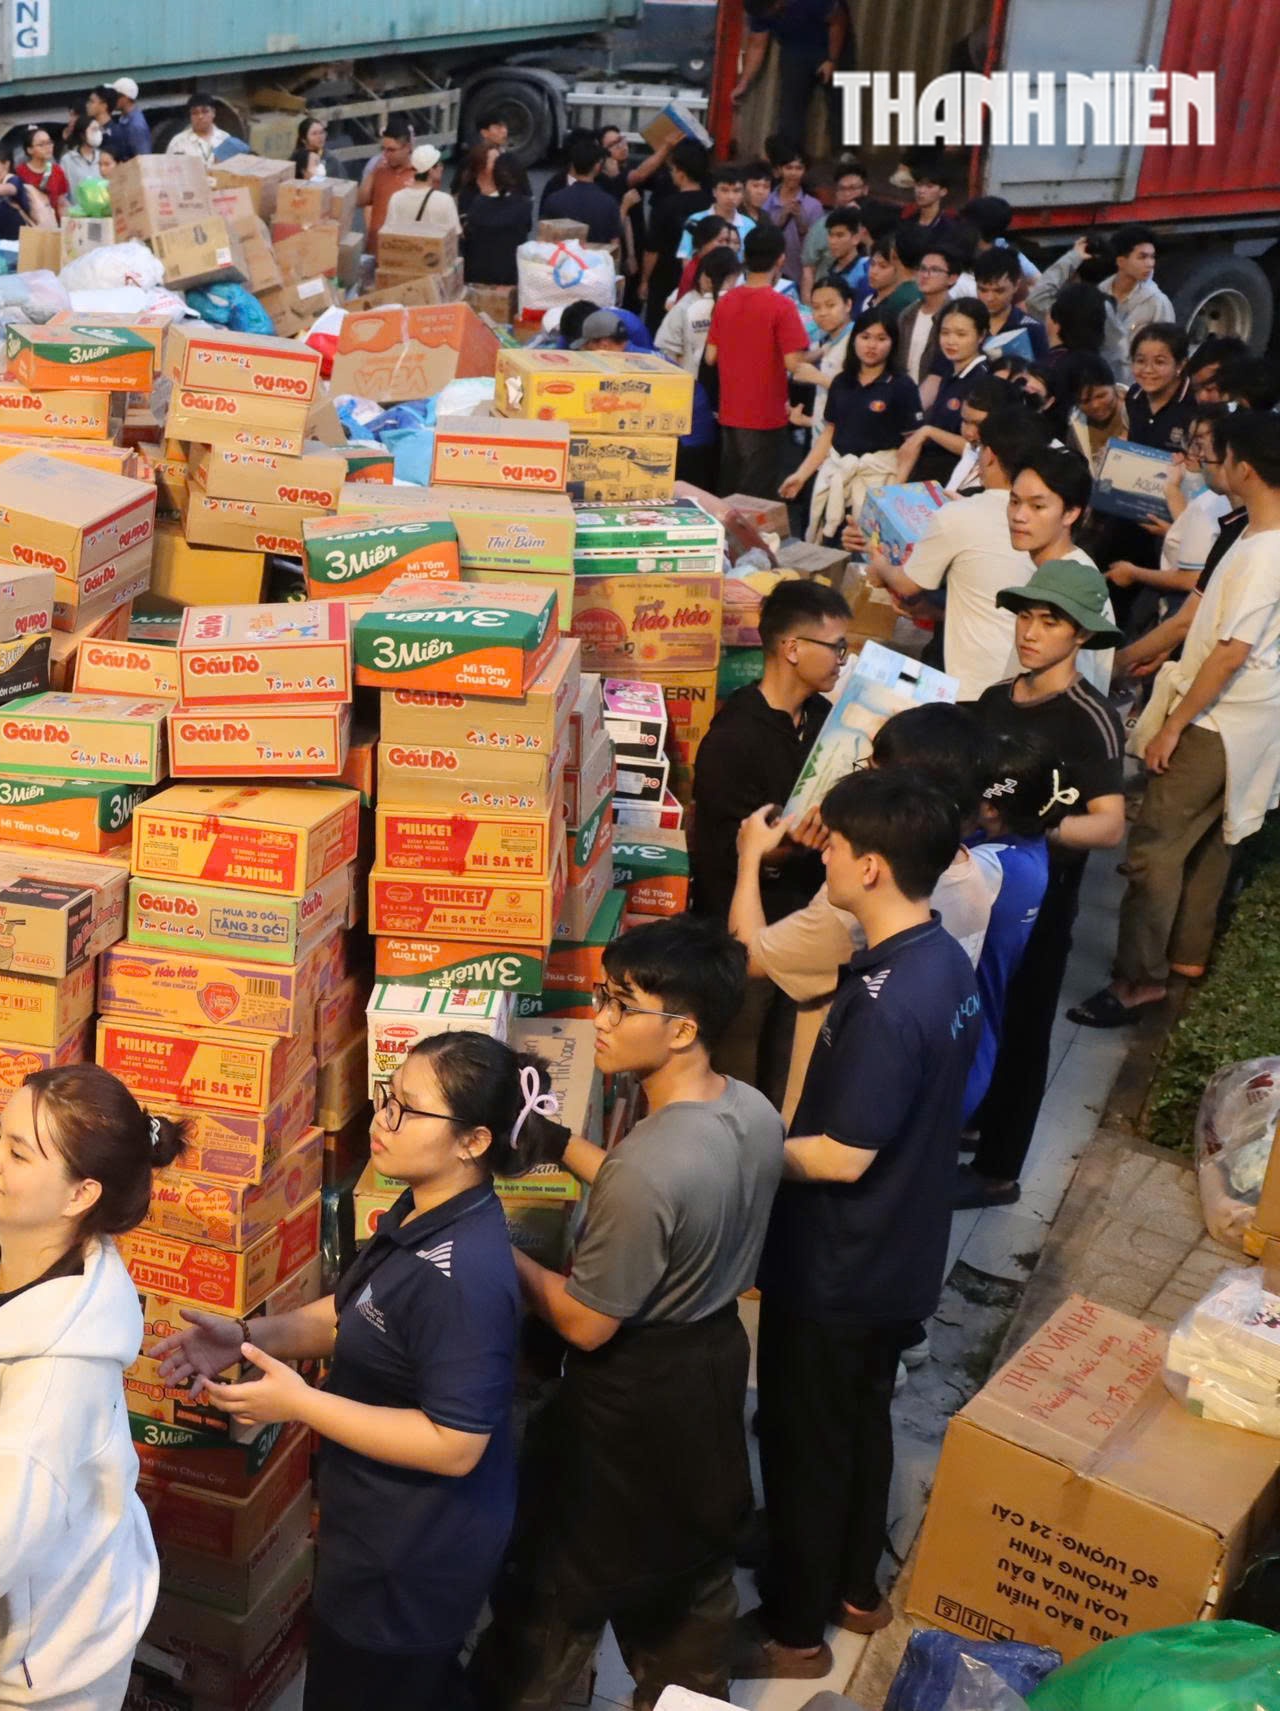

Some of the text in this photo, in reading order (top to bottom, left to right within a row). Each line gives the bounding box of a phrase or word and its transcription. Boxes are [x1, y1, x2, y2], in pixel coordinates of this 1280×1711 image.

[22, 396, 42, 410] Đỏ
[181, 392, 237, 414] Gấu Đỏ
[502, 464, 558, 483] Gấu Đỏ
[407, 560, 444, 570] Mì Tôm
[430, 569, 450, 578] Cay
[189, 654, 260, 675] Gấu Đỏ
[463, 664, 505, 676] Mì Tôm
[265, 676, 336, 690] Tôm và Gà
[456, 674, 511, 689] Chua Cay
[180, 722, 250, 742] Gấu Đỏ
[466, 731, 542, 748] Gà Sợi Phở
[70, 750, 97, 766] Chay
[100, 752, 122, 764] Rau
[256, 747, 326, 759] Tôm và Gà
[388, 748, 458, 770] Gấu Đỏ
[0, 818, 80, 840] Mì Tôm Chua Cay
[472, 853, 534, 868] MÌ SA TẾ
[224, 864, 283, 883] MILIKET
[137, 893, 198, 916] Gấu Đỏ
[423, 887, 486, 907] MILIKET
[223, 908, 277, 921] MUA 30 GÓI
[432, 913, 448, 924] MÌ
[450, 915, 467, 925] SA
[494, 916, 533, 925] PLASMA
[137, 918, 205, 939] Tôm Chua Cay
[214, 918, 250, 933] TẶNG
[252, 921, 260, 932] 3
[386, 940, 441, 954] Chua Cay
[116, 1036, 174, 1056] MILIKET
[190, 1078, 252, 1098] MÌ SA TẾ
[992, 1503, 1160, 1589] SỐ LƯỢNG: 24 CÁI
[1009, 1537, 1128, 1601] KHÔNG KÍNH
[996, 1582, 1040, 1611] HIỂM
[997, 1557, 1130, 1627] LOẠI NỬA ĐẦU
[1044, 1604, 1083, 1631] BẢO
